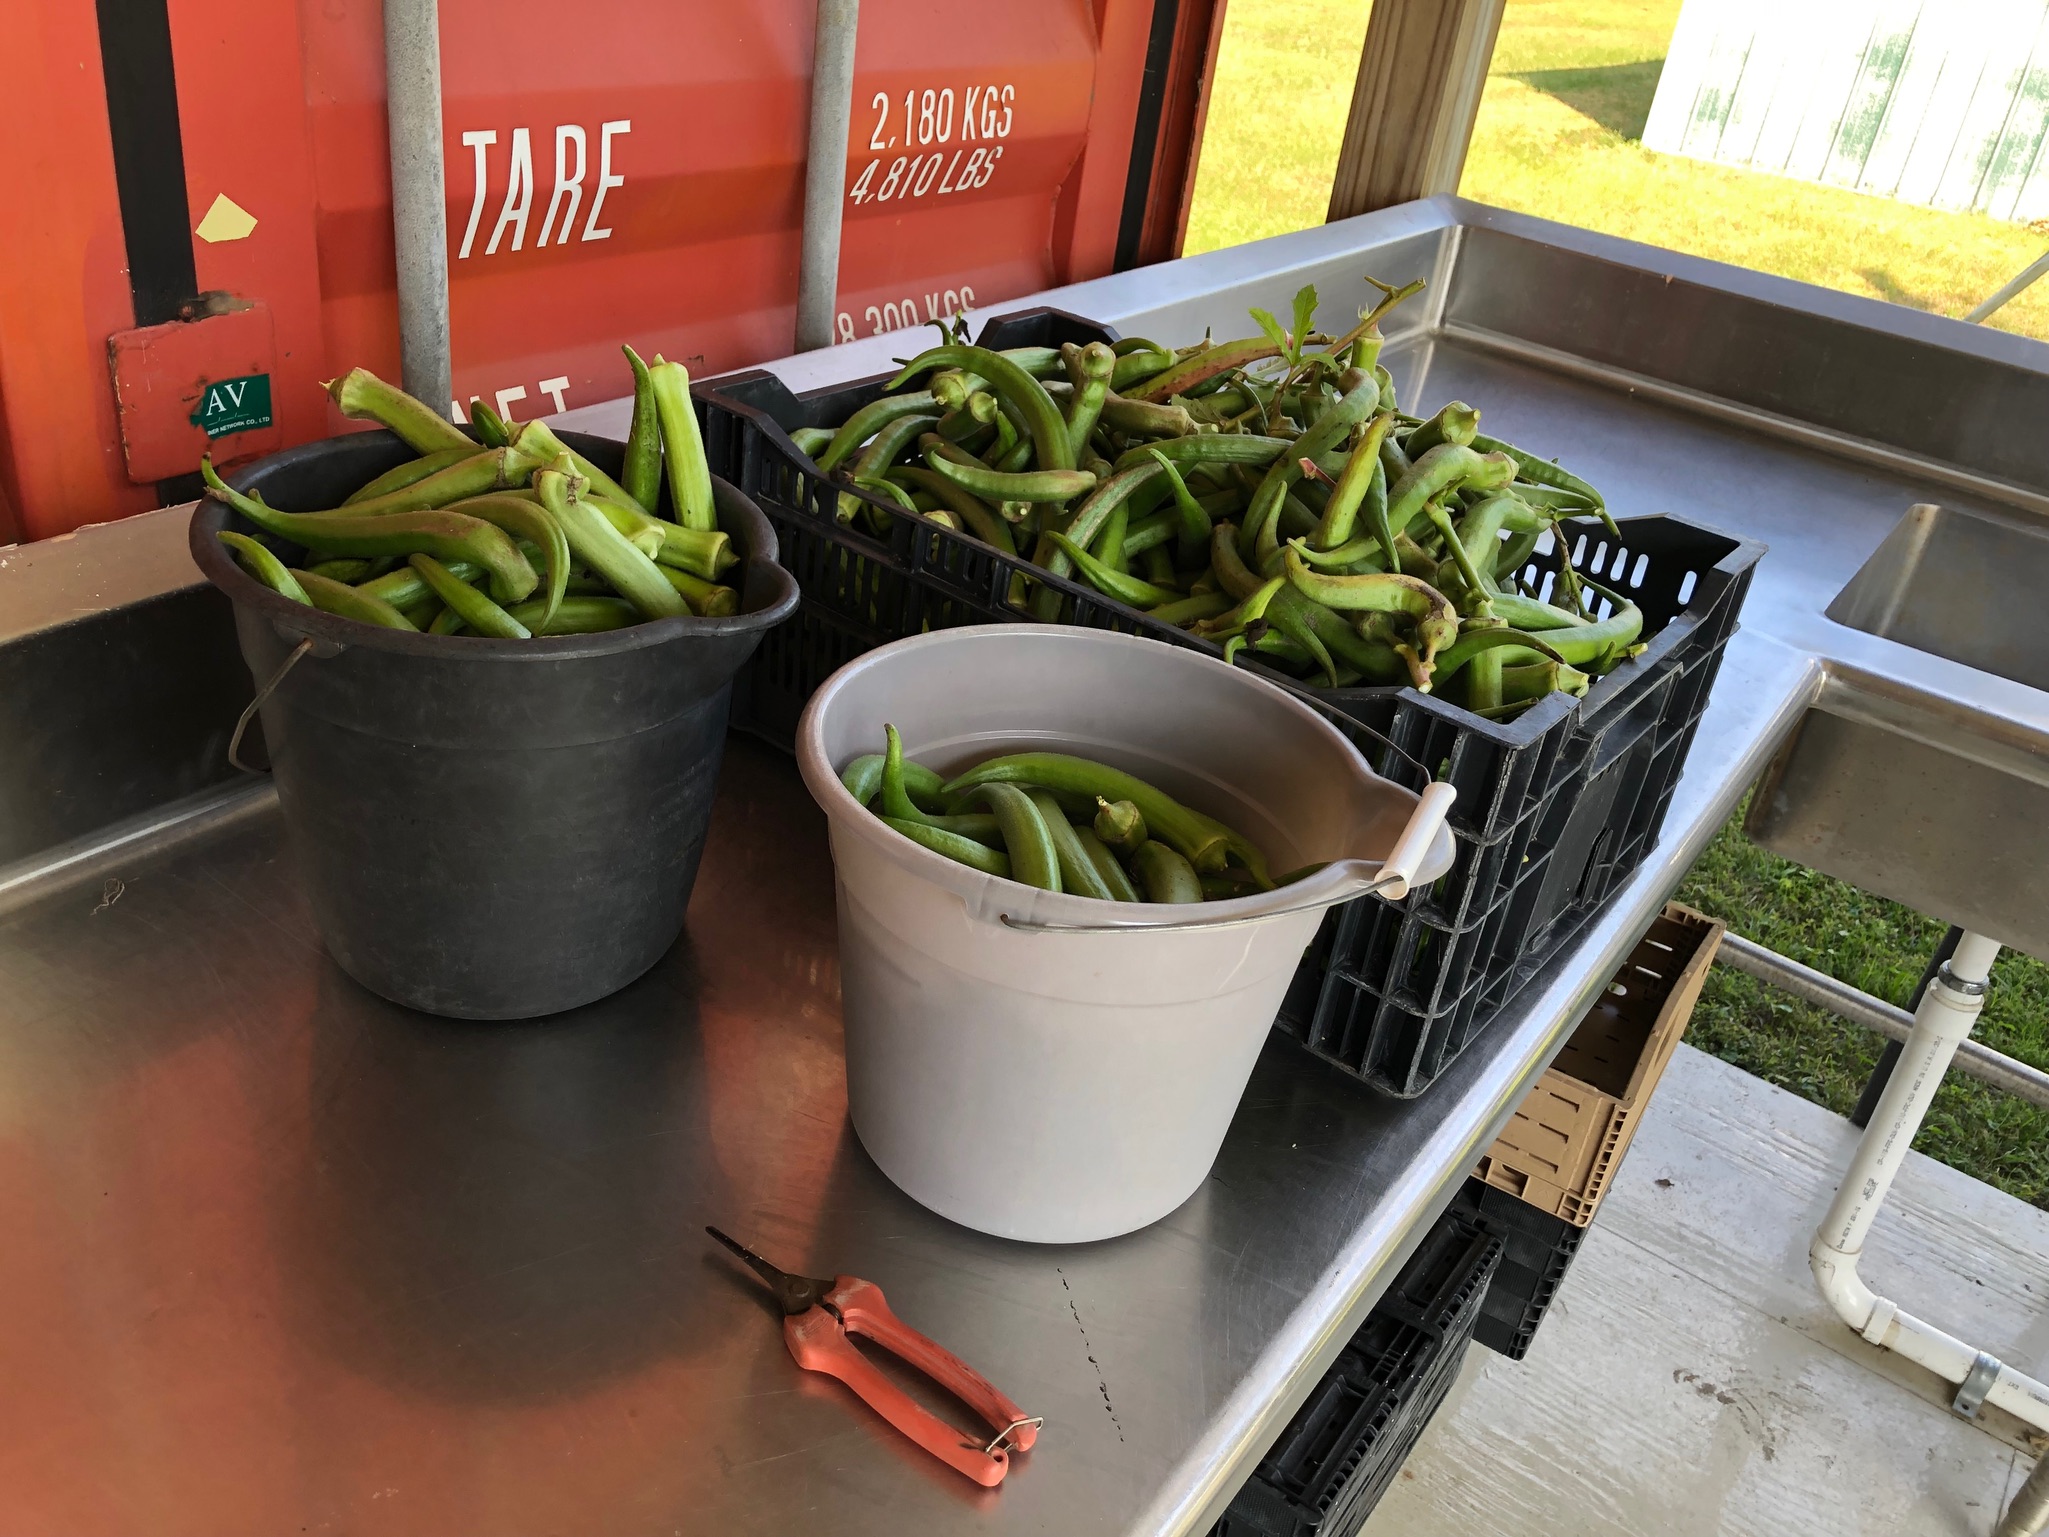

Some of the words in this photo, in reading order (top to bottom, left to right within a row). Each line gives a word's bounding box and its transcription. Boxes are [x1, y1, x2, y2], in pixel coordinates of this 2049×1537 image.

[870, 87, 955, 151] 2,180
[961, 84, 1015, 140] KGS
[458, 119, 631, 260] TARE
[849, 152, 944, 205] 4,810
[937, 145, 1004, 194] LBS
[206, 381, 247, 416] AV
[220, 421, 245, 432] NETWORK
